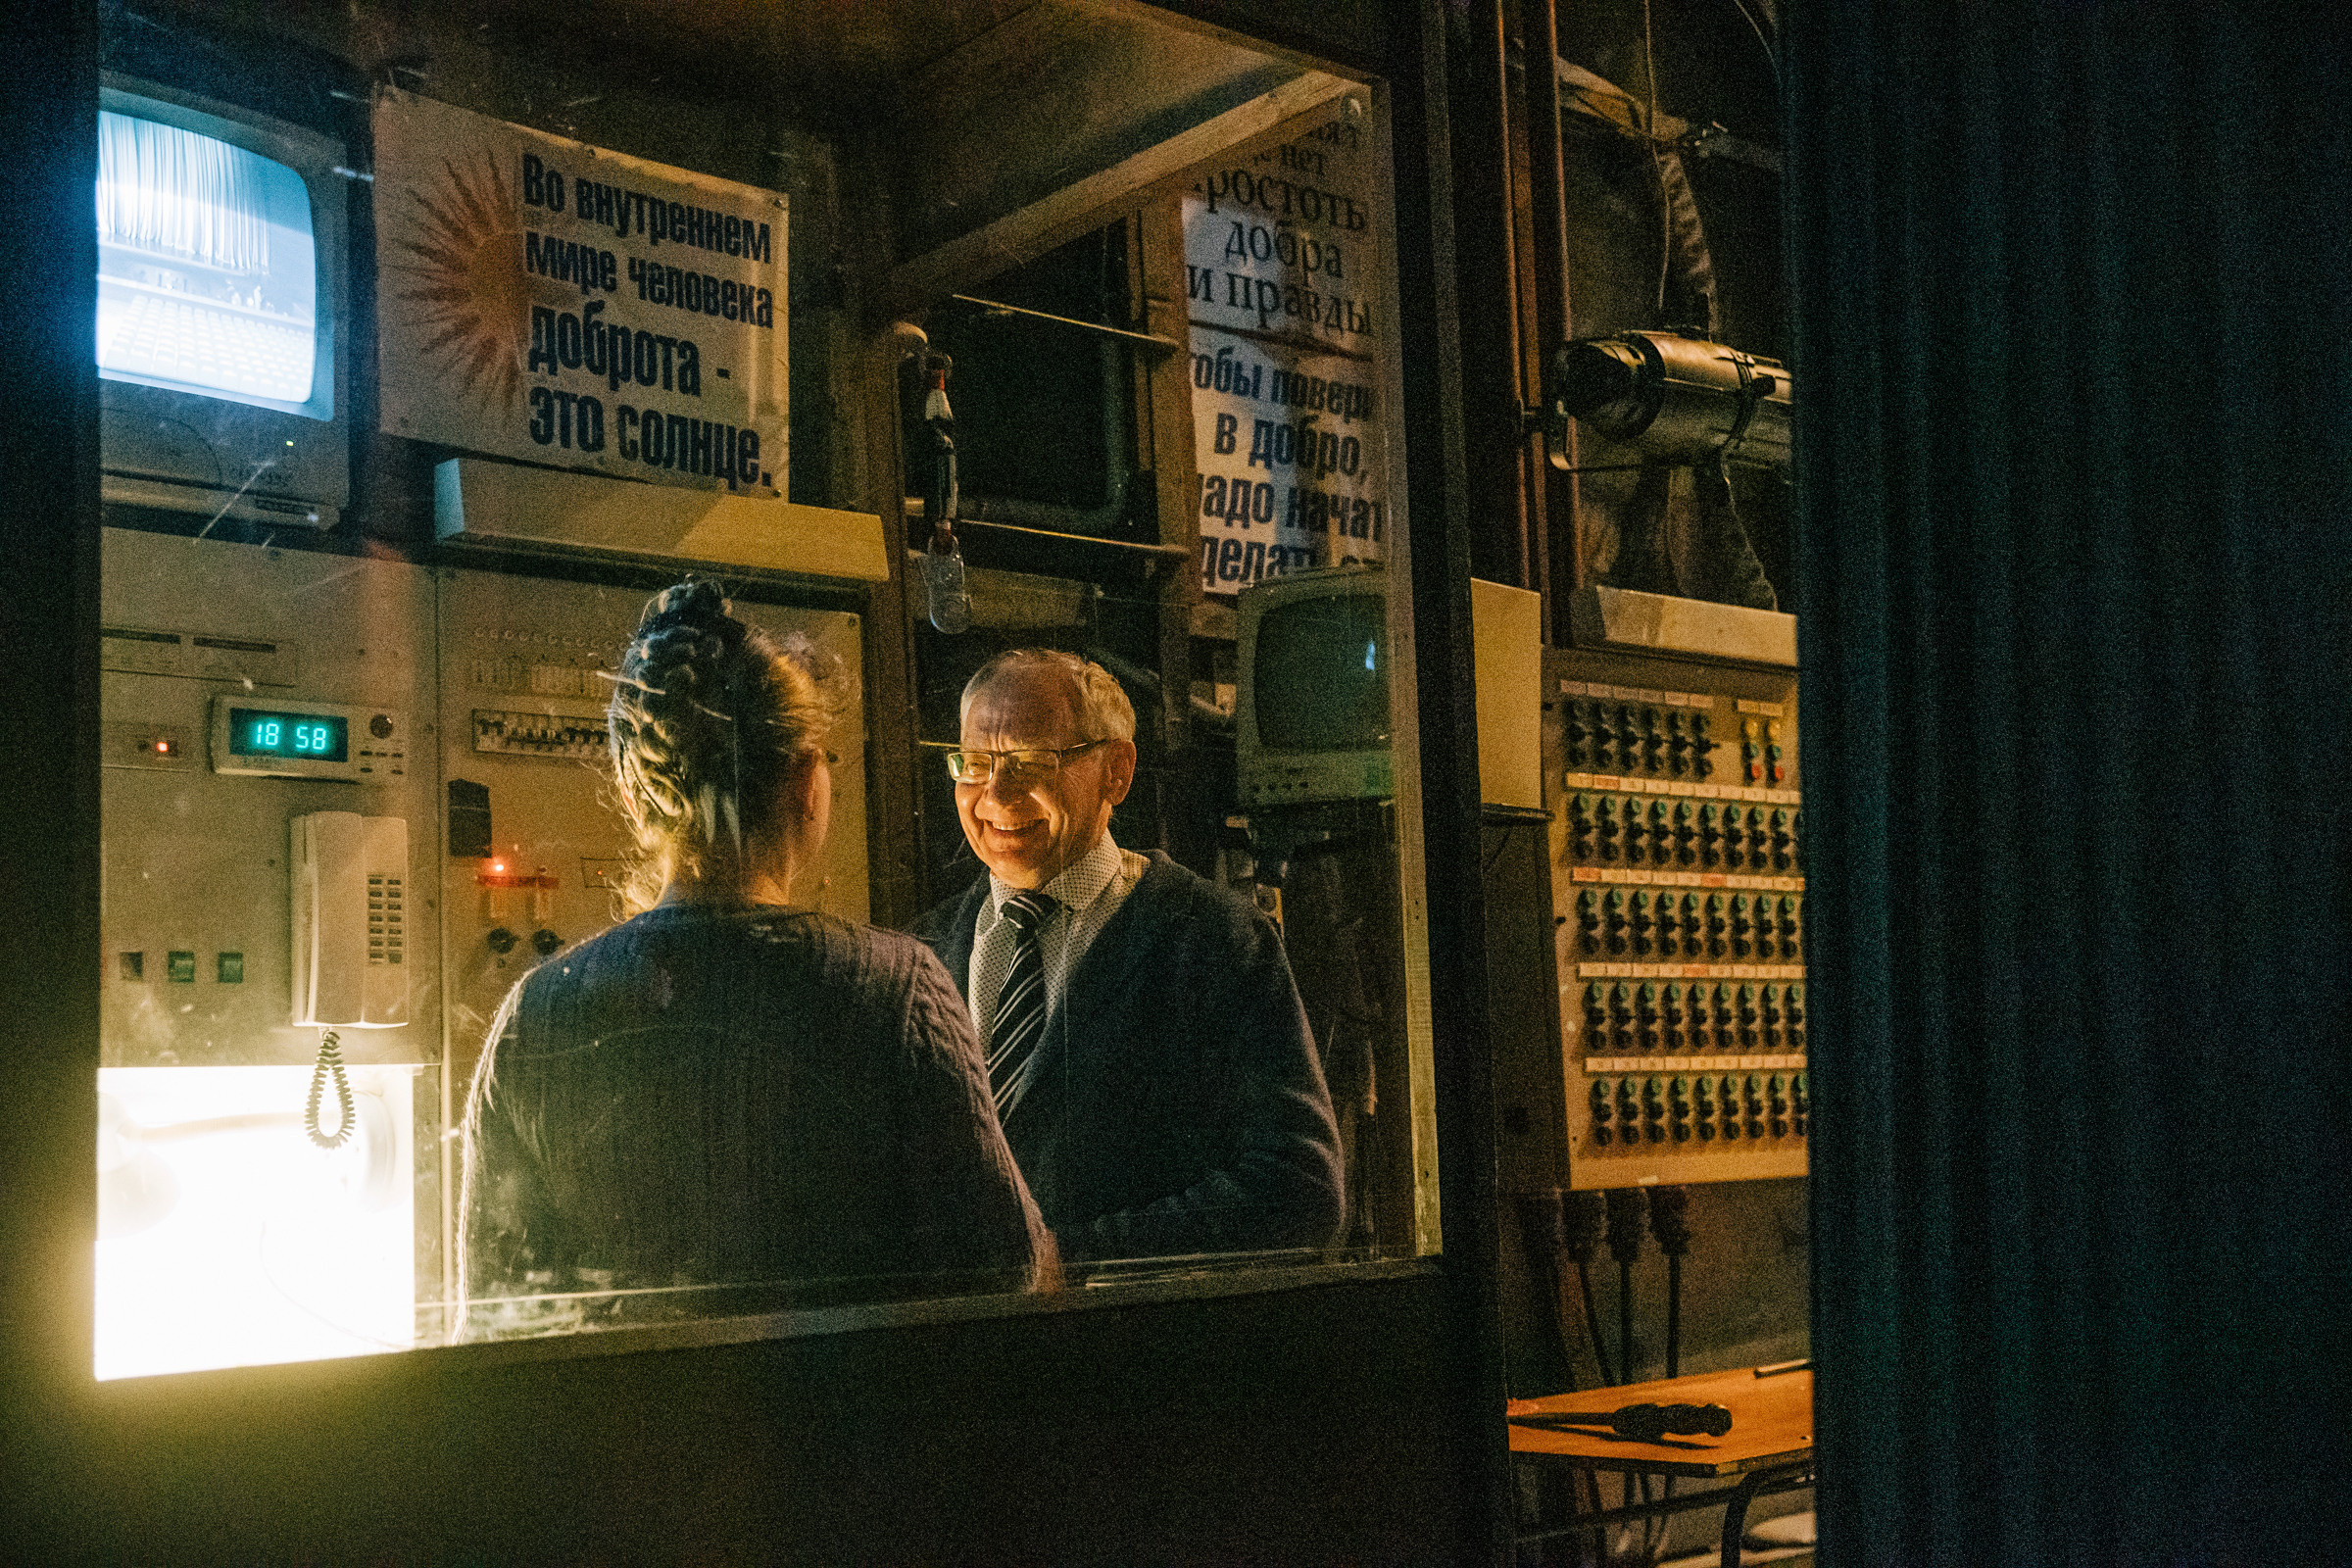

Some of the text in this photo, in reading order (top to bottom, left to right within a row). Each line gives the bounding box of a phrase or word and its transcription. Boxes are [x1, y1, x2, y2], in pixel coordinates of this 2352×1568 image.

[523, 154, 772, 265] Во внутреннем
[524, 231, 774, 329] мире человека
[1225, 220, 1344, 288] добра
[1187, 265, 1373, 338] и правды
[527, 300, 702, 397] доброта
[1192, 346, 1263, 399] обы
[528, 386, 773, 490] это солнце.
[1198, 472, 1274, 529] адо
[257, 723, 326, 750] 18 58
